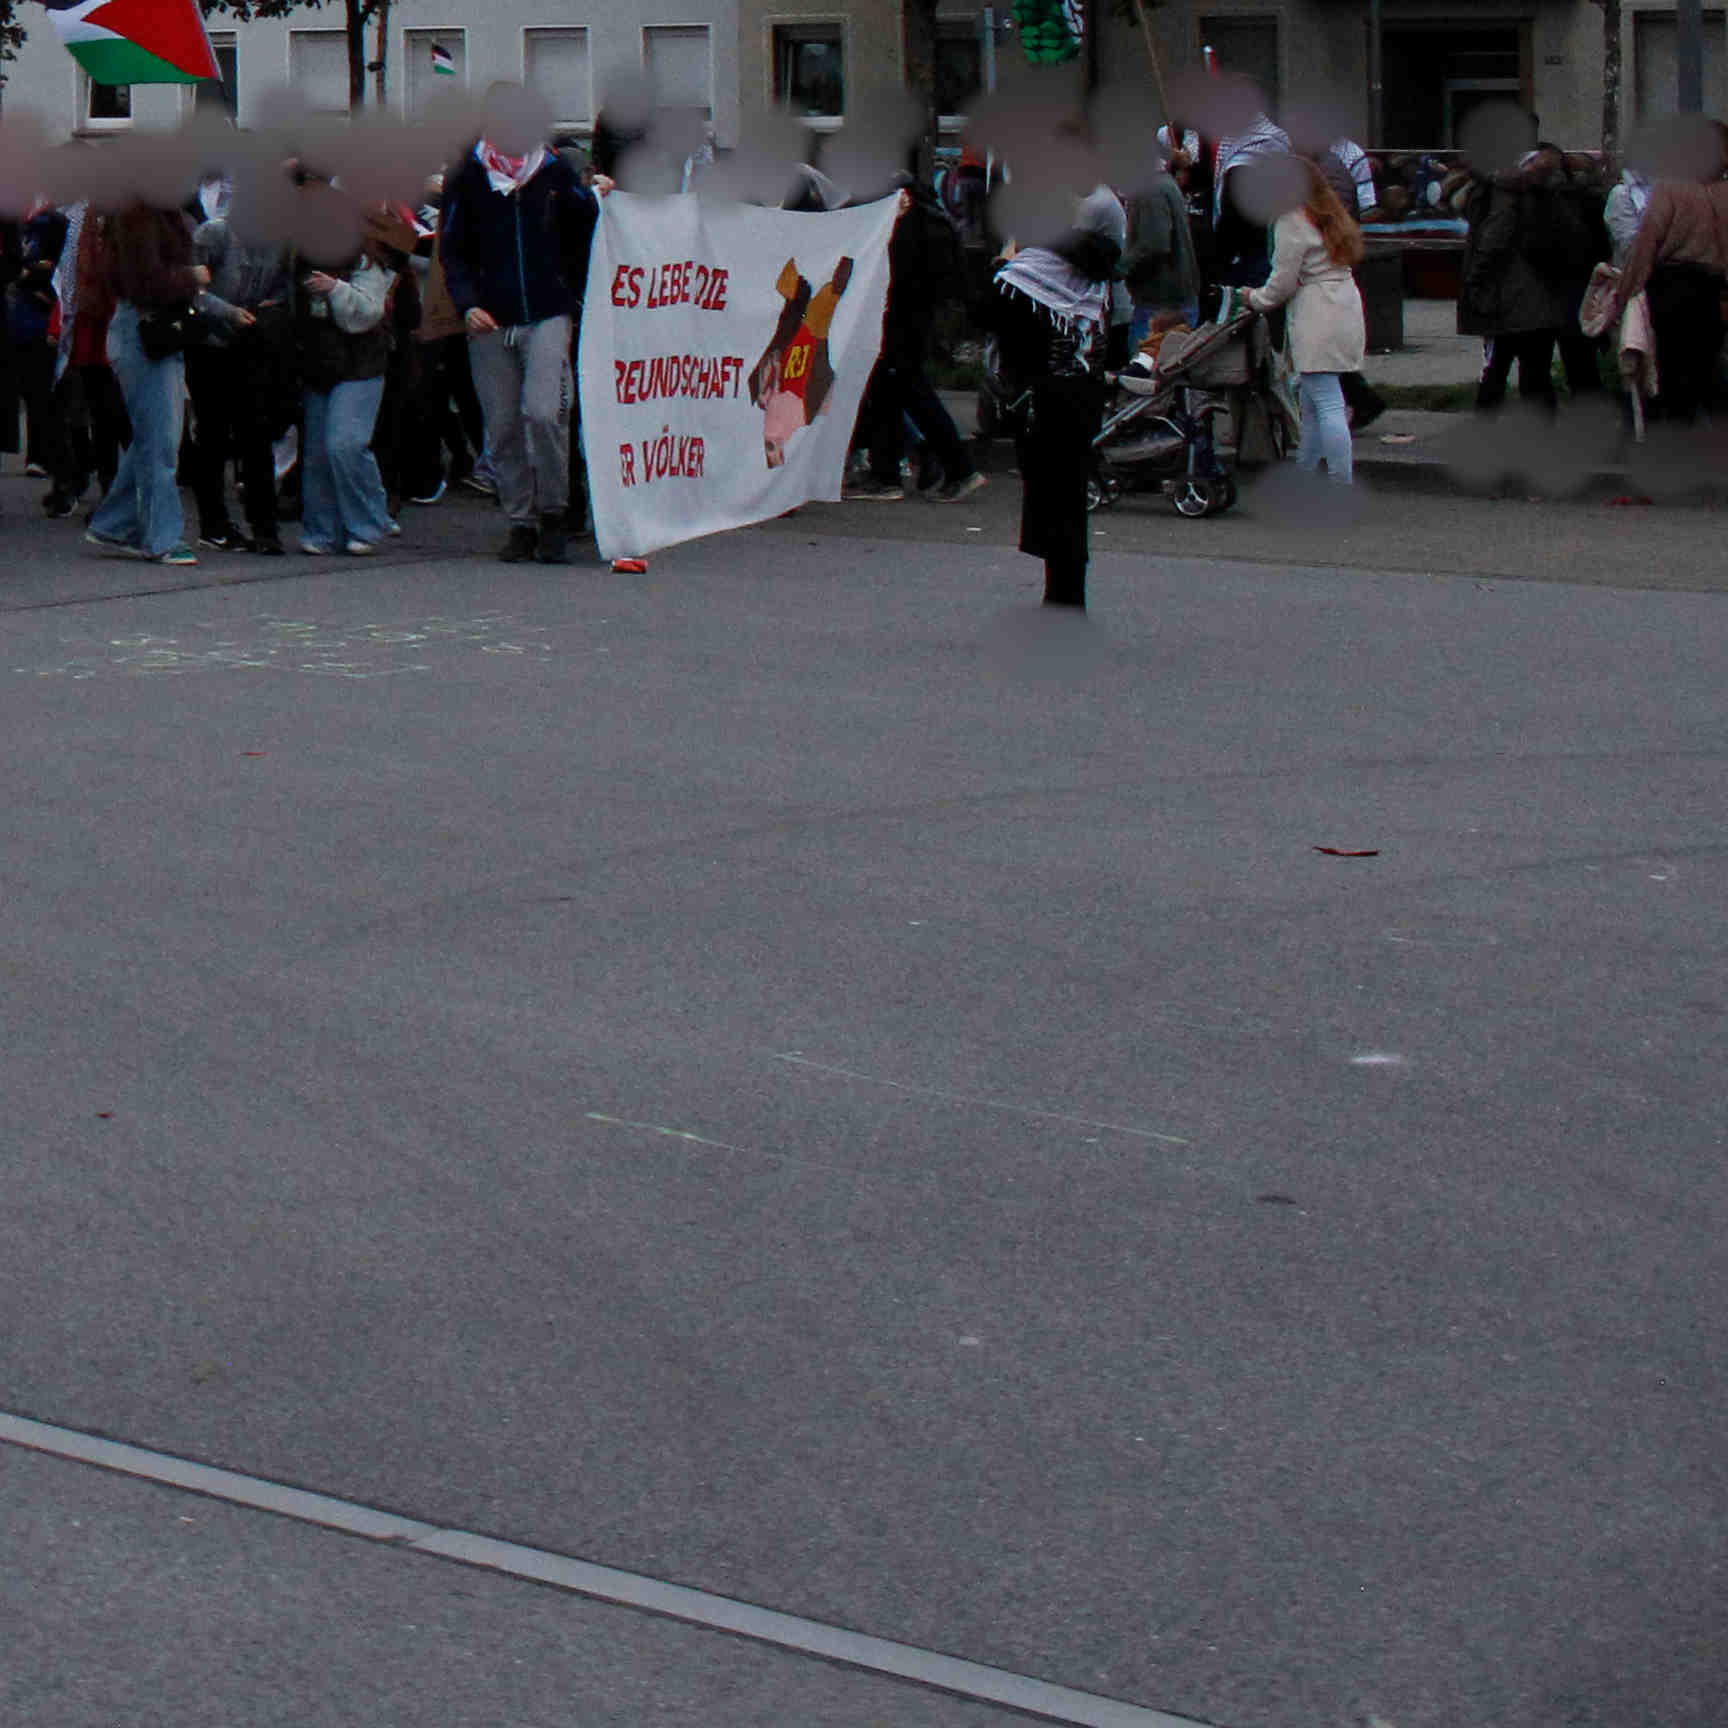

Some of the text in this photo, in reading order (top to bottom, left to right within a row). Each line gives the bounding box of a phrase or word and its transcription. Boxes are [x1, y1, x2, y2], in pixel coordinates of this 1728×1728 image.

[610, 264, 644, 309] ES
[646, 260, 694, 310] LEBE
[643, 424, 706, 483] VÖLKER
